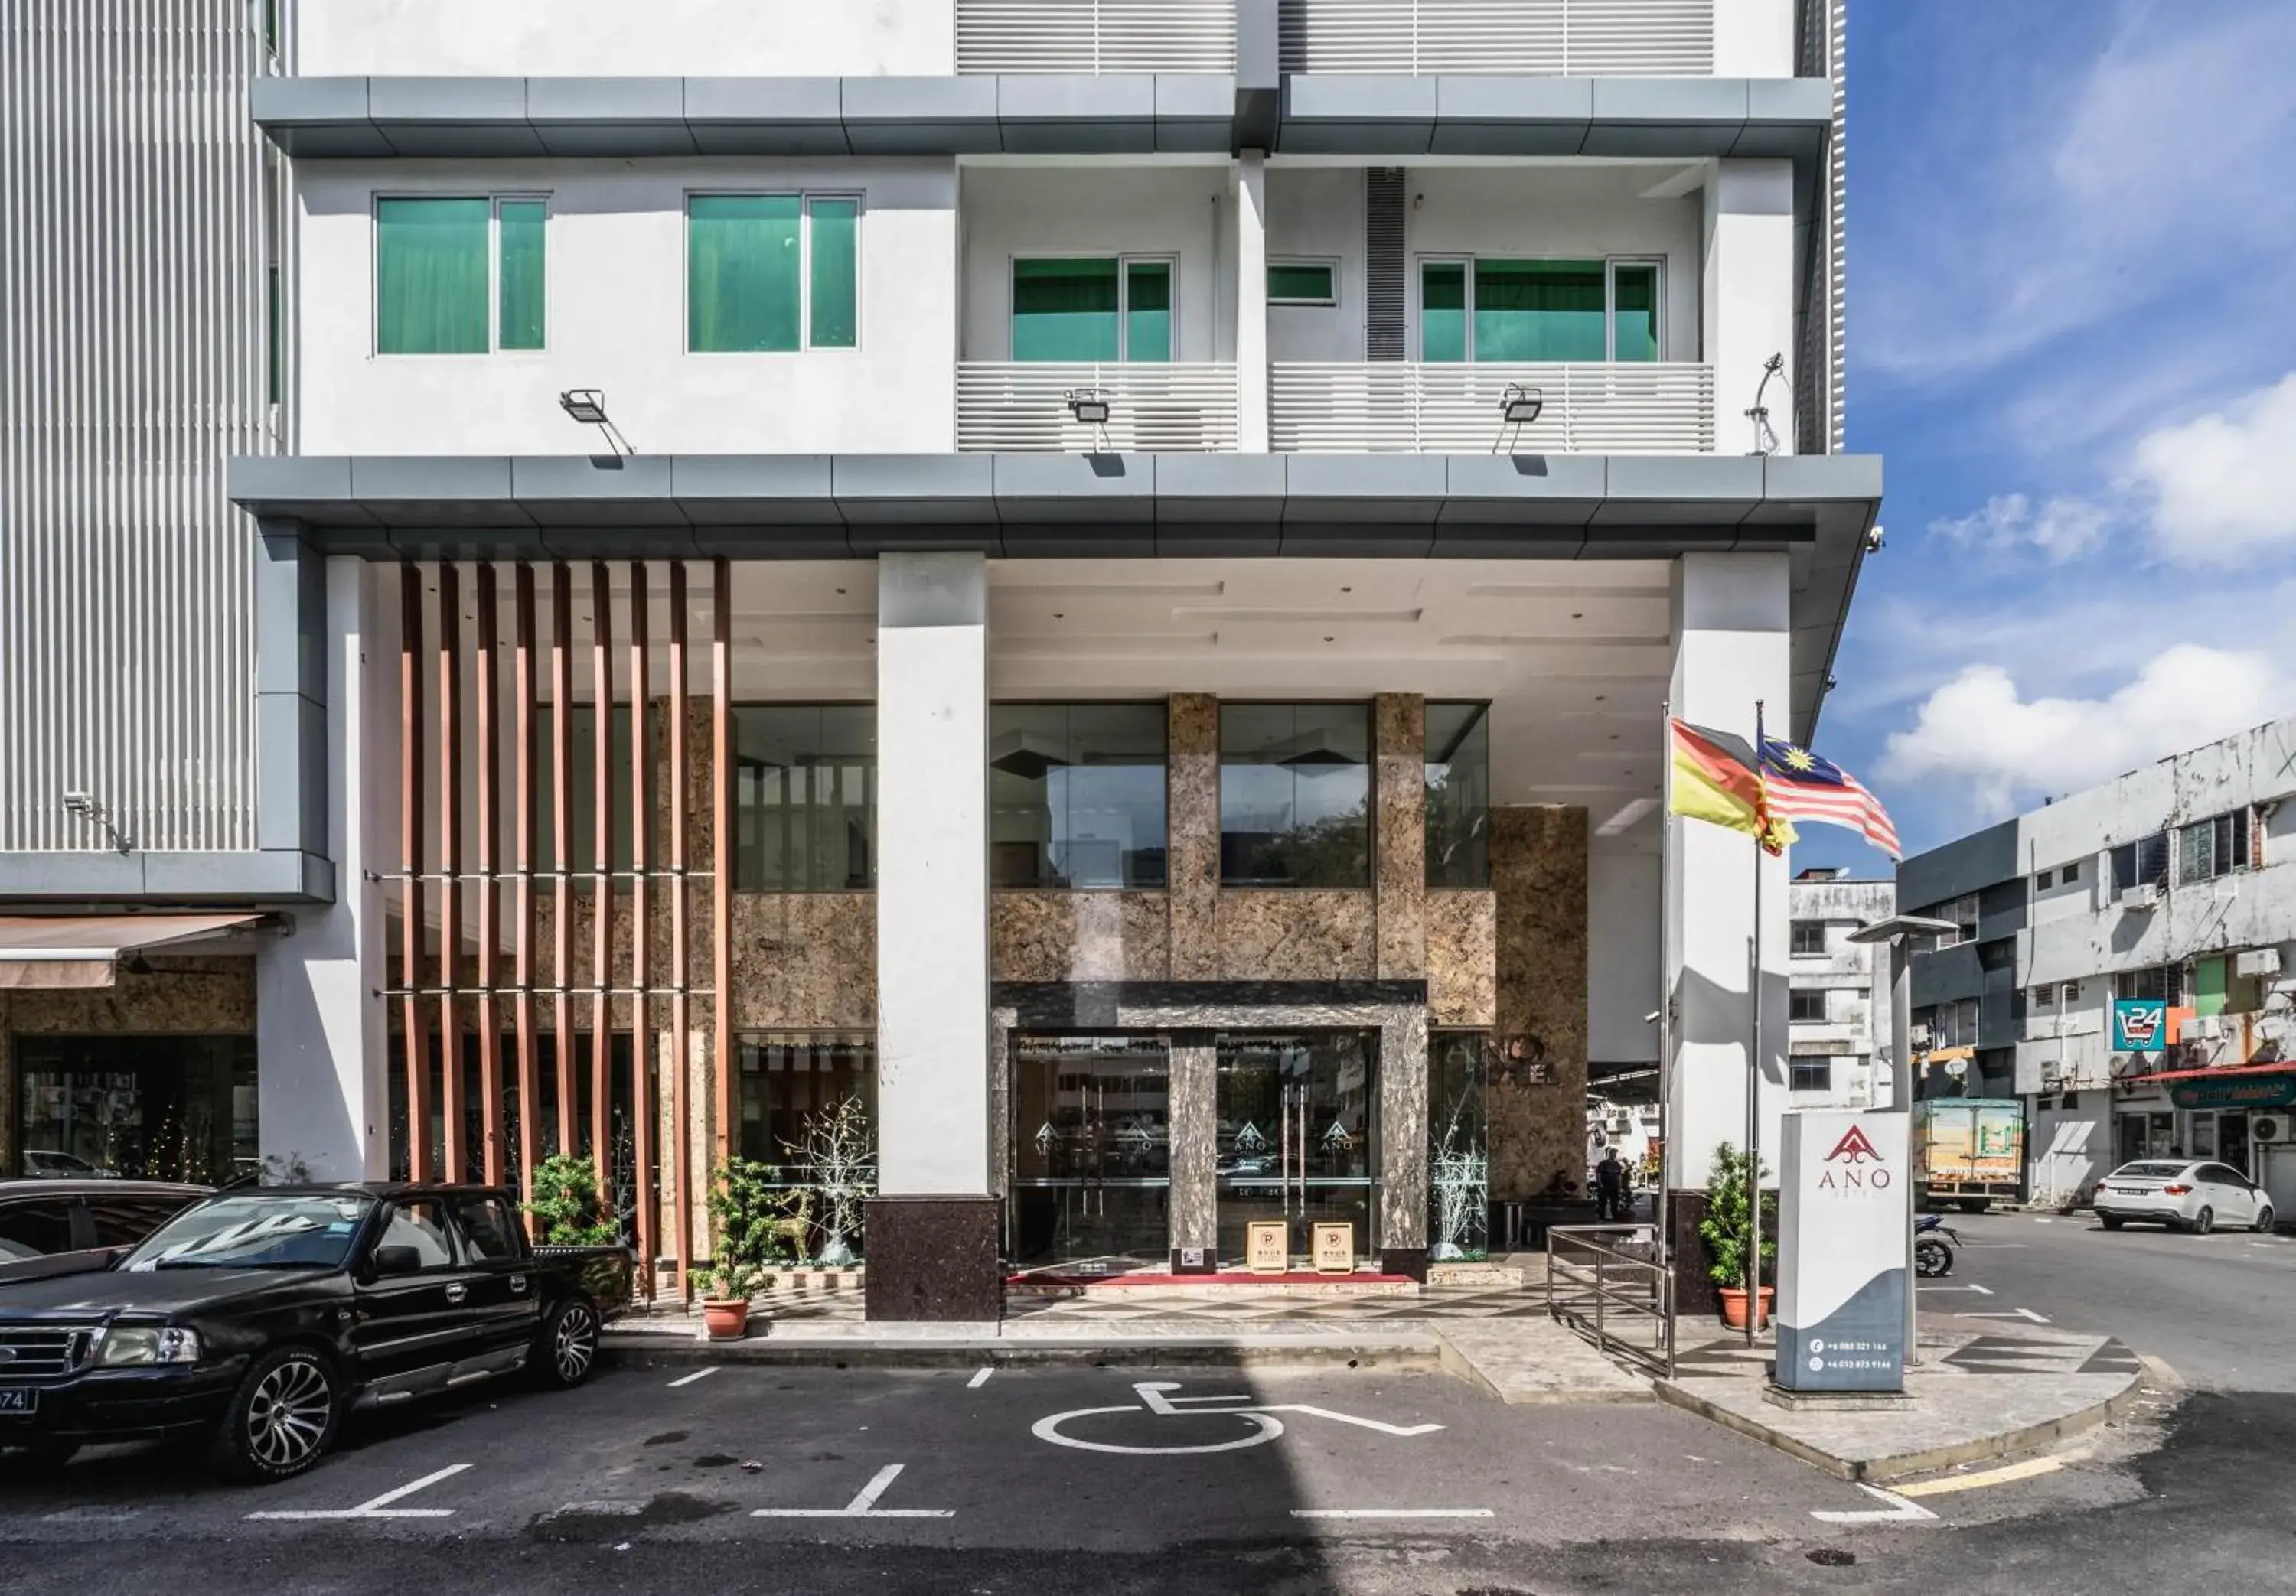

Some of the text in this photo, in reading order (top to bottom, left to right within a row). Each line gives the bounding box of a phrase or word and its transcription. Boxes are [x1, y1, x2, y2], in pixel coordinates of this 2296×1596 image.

[2128, 1008, 2162, 1028] 24
[1234, 1141, 1267, 1151] ANO
[1322, 1141, 1353, 1151] ANO
[1818, 1168, 1890, 1188] ANO
[0, 1392, 24, 1408] 74
